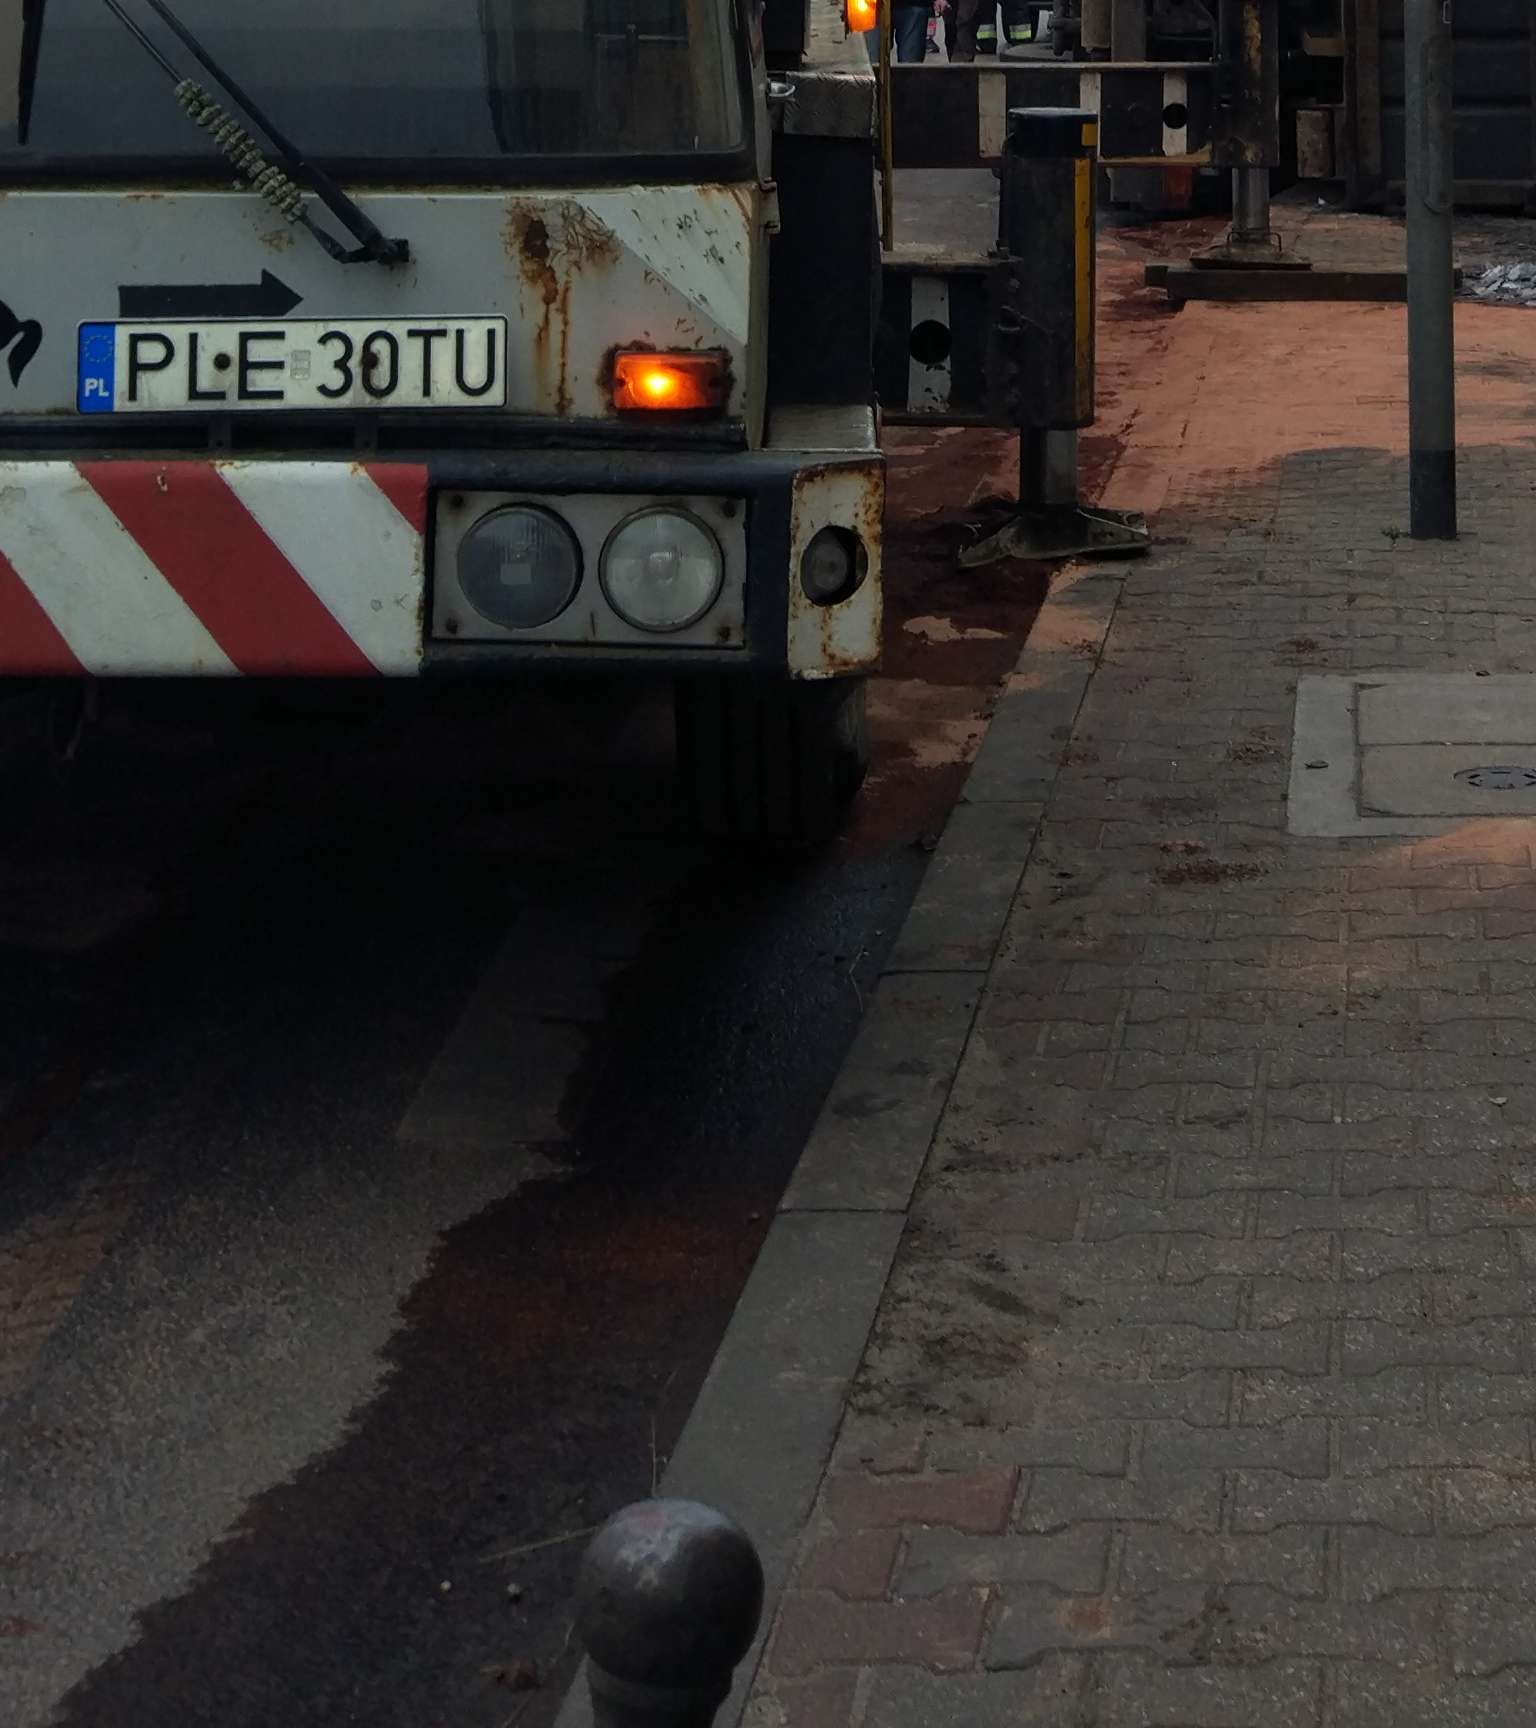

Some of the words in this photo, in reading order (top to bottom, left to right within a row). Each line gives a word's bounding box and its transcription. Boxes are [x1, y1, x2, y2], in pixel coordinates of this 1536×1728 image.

[84, 378, 110, 398] PL
[126, 329, 287, 403] PLE
[316, 326, 498, 399] 30TU
